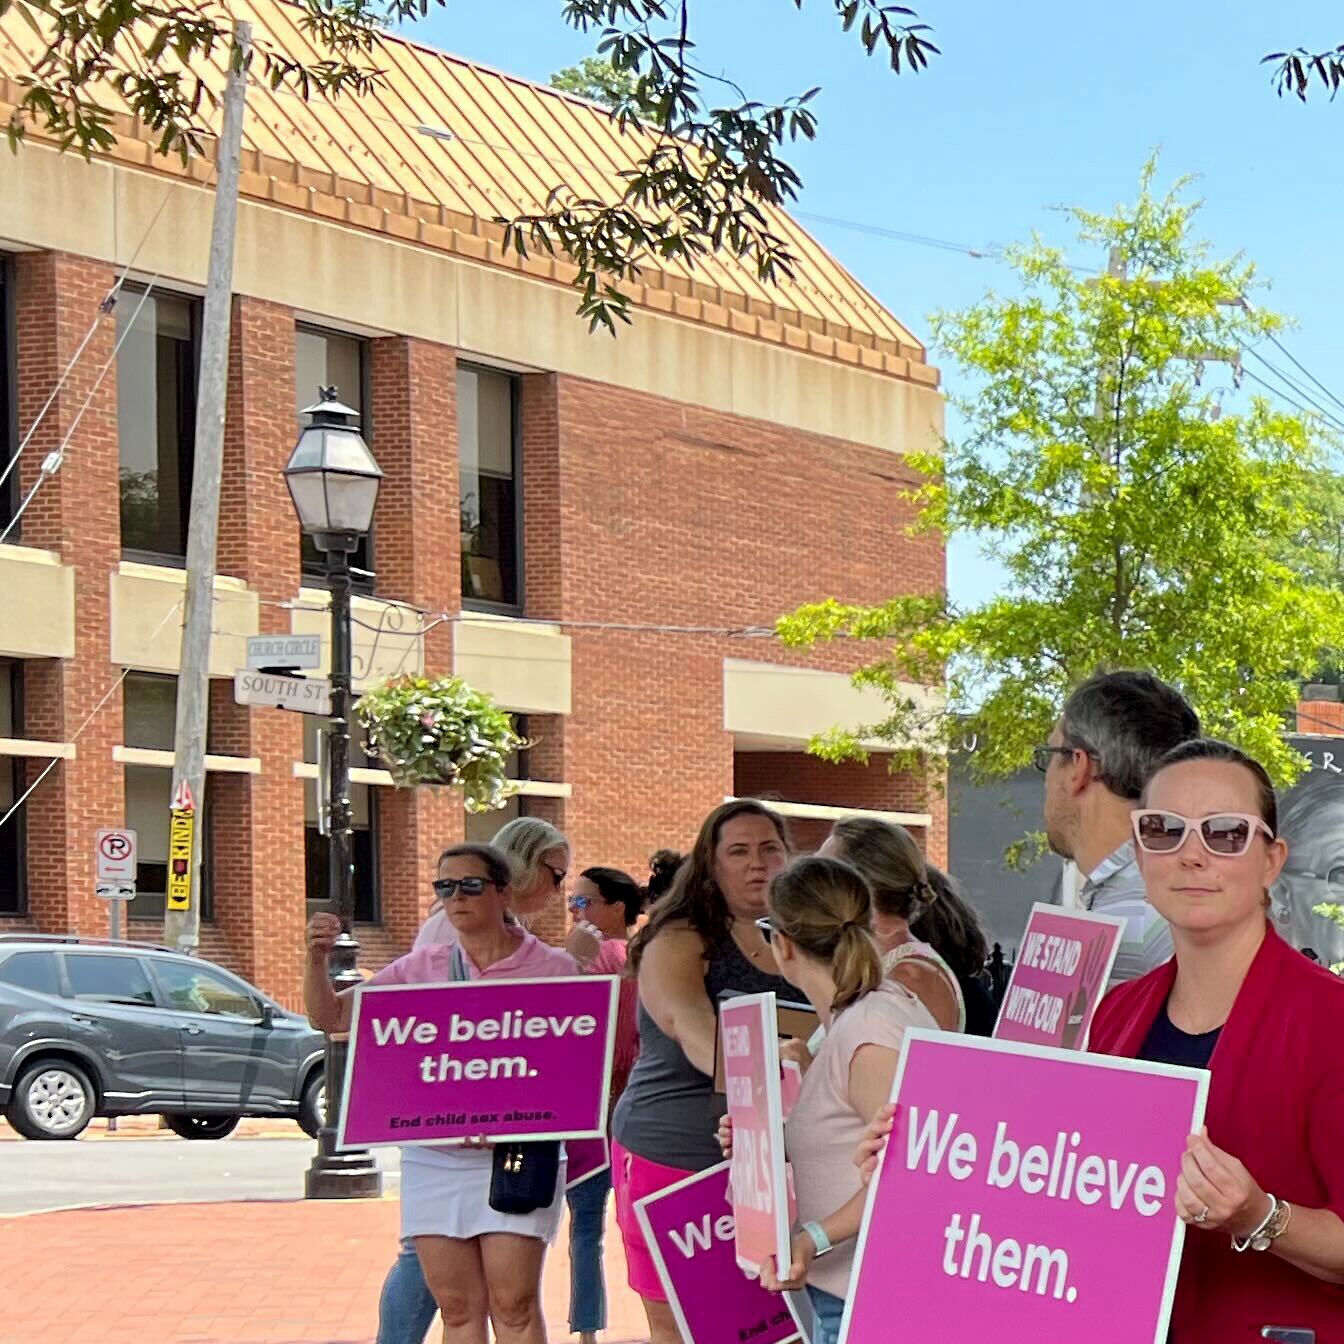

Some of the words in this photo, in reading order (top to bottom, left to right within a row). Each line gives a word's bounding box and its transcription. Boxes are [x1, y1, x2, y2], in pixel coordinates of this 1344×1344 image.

[248, 641, 284, 657] CHURCH
[284, 639, 316, 656] CIRCLE
[241, 675, 299, 697] SOUTH
[1022, 931, 1046, 969] WE
[1040, 935, 1082, 977] STAND
[371, 1015, 438, 1046] We
[449, 1009, 597, 1042] believe
[1005, 984, 1041, 1024] WITH
[1034, 993, 1064, 1035] OUR
[419, 1053, 539, 1083] them.
[389, 1116, 421, 1129] End
[425, 1112, 466, 1126] child
[470, 1112, 499, 1125] sex
[503, 1109, 559, 1122] abuse.
[905, 1105, 979, 1182] We
[986, 1121, 1167, 1218] believe
[668, 1213, 737, 1259] We
[942, 1213, 1080, 1304] them.
[738, 1320, 769, 1342] End
